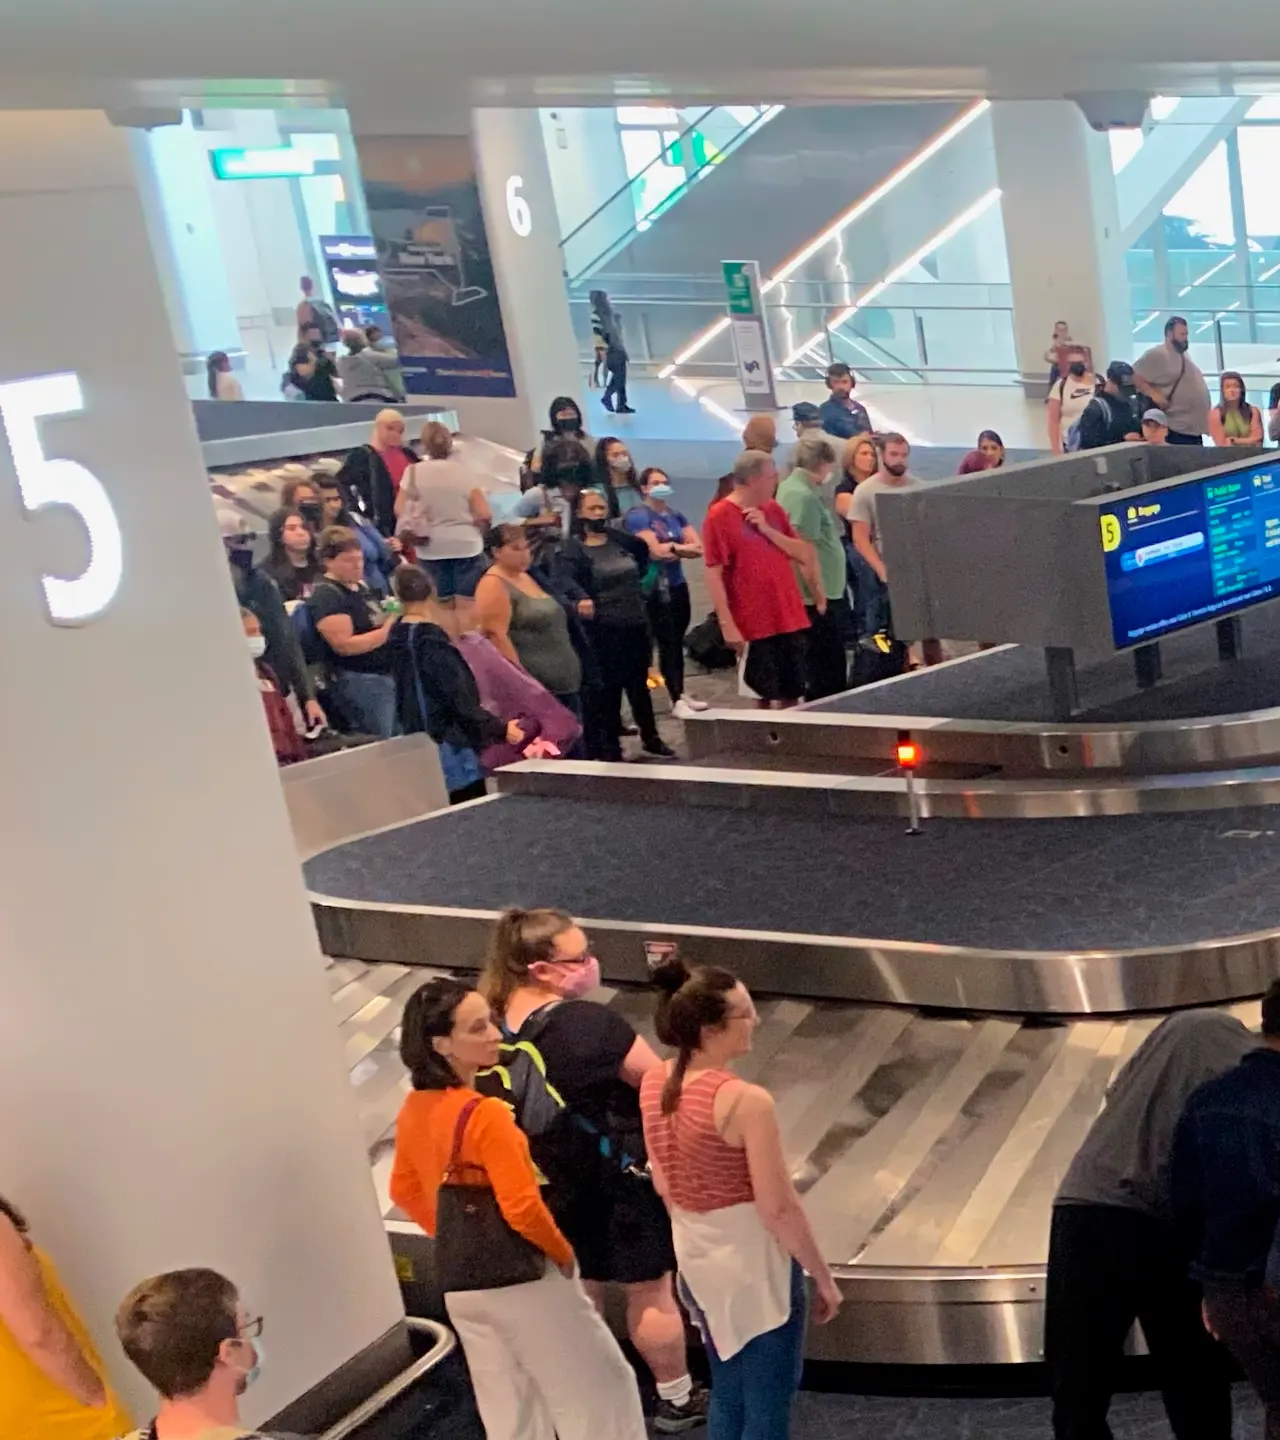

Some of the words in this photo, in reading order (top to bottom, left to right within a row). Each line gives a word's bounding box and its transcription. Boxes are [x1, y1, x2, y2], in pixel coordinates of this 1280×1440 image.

[505, 175, 532, 237] 6
[0, 372, 122, 627] 5
[1105, 527, 1115, 544] 5
